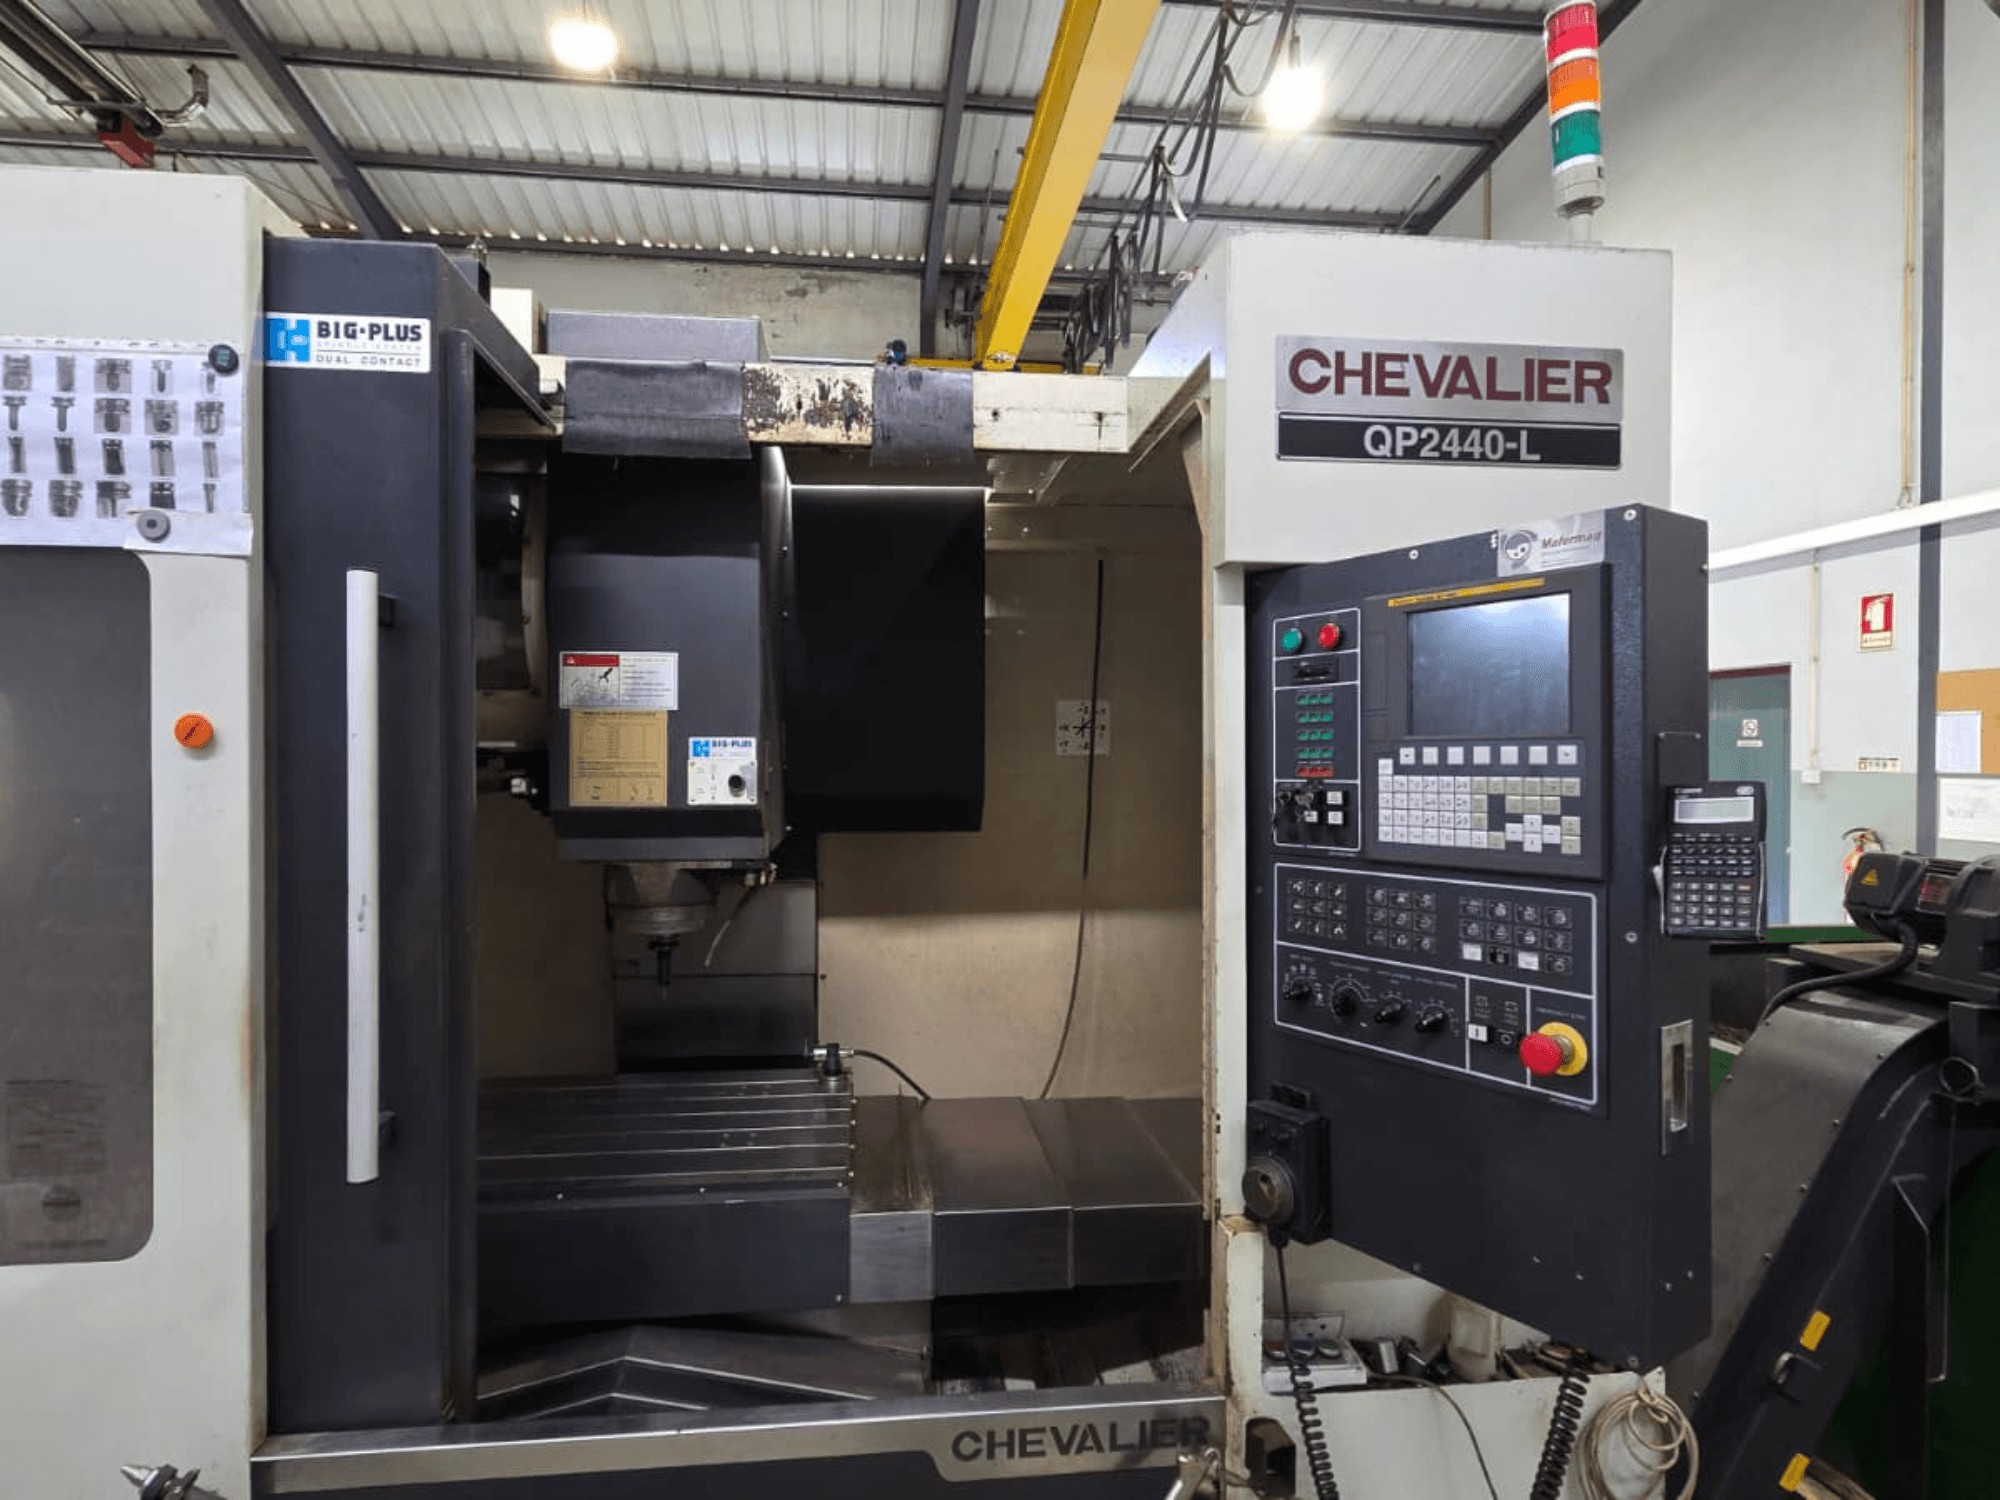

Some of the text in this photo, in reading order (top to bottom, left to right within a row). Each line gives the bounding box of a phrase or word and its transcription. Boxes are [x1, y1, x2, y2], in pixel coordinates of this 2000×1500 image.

[316, 354, 420, 366] DUAL CONTACT
[1288, 347, 1613, 404] CHEVALIER
[1363, 424, 1541, 461] QP2440-L
[951, 1415, 1210, 1461] CHEVALIER
